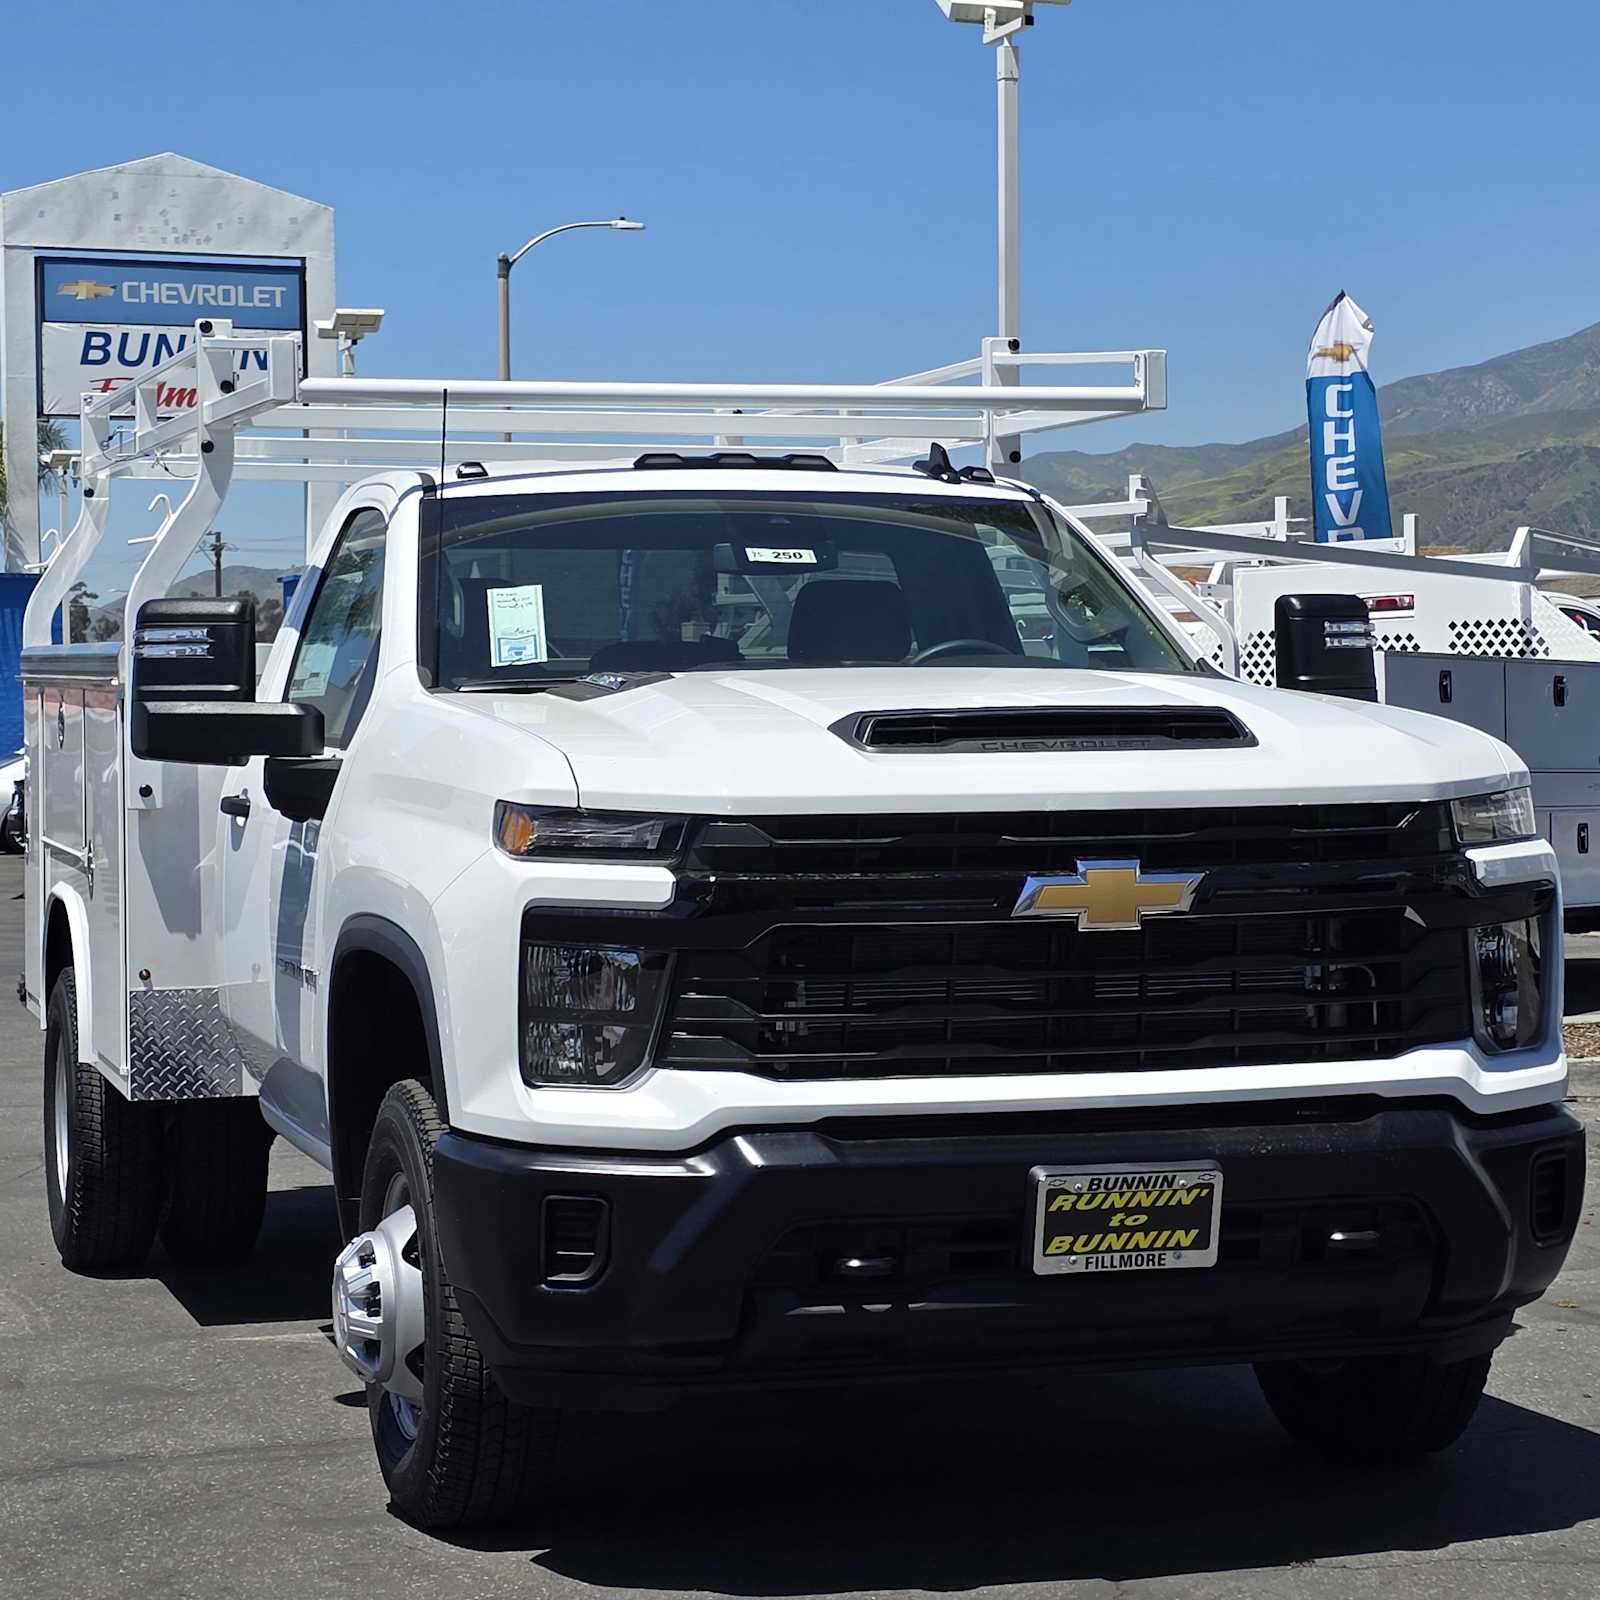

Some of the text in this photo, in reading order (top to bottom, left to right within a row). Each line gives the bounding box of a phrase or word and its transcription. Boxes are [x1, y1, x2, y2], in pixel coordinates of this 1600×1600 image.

[121, 281, 287, 309] CHEVROLET
[771, 551, 803, 560] 250
[981, 739, 1151, 751] CHEVROLET
[1087, 1174, 1177, 1192] BUNNIN
[1048, 1188, 1210, 1212] RUNNIN'
[1108, 1212, 1149, 1227] to
[1044, 1229, 1200, 1255] BUNNIN
[1085, 1253, 1167, 1270] FILLMORE
